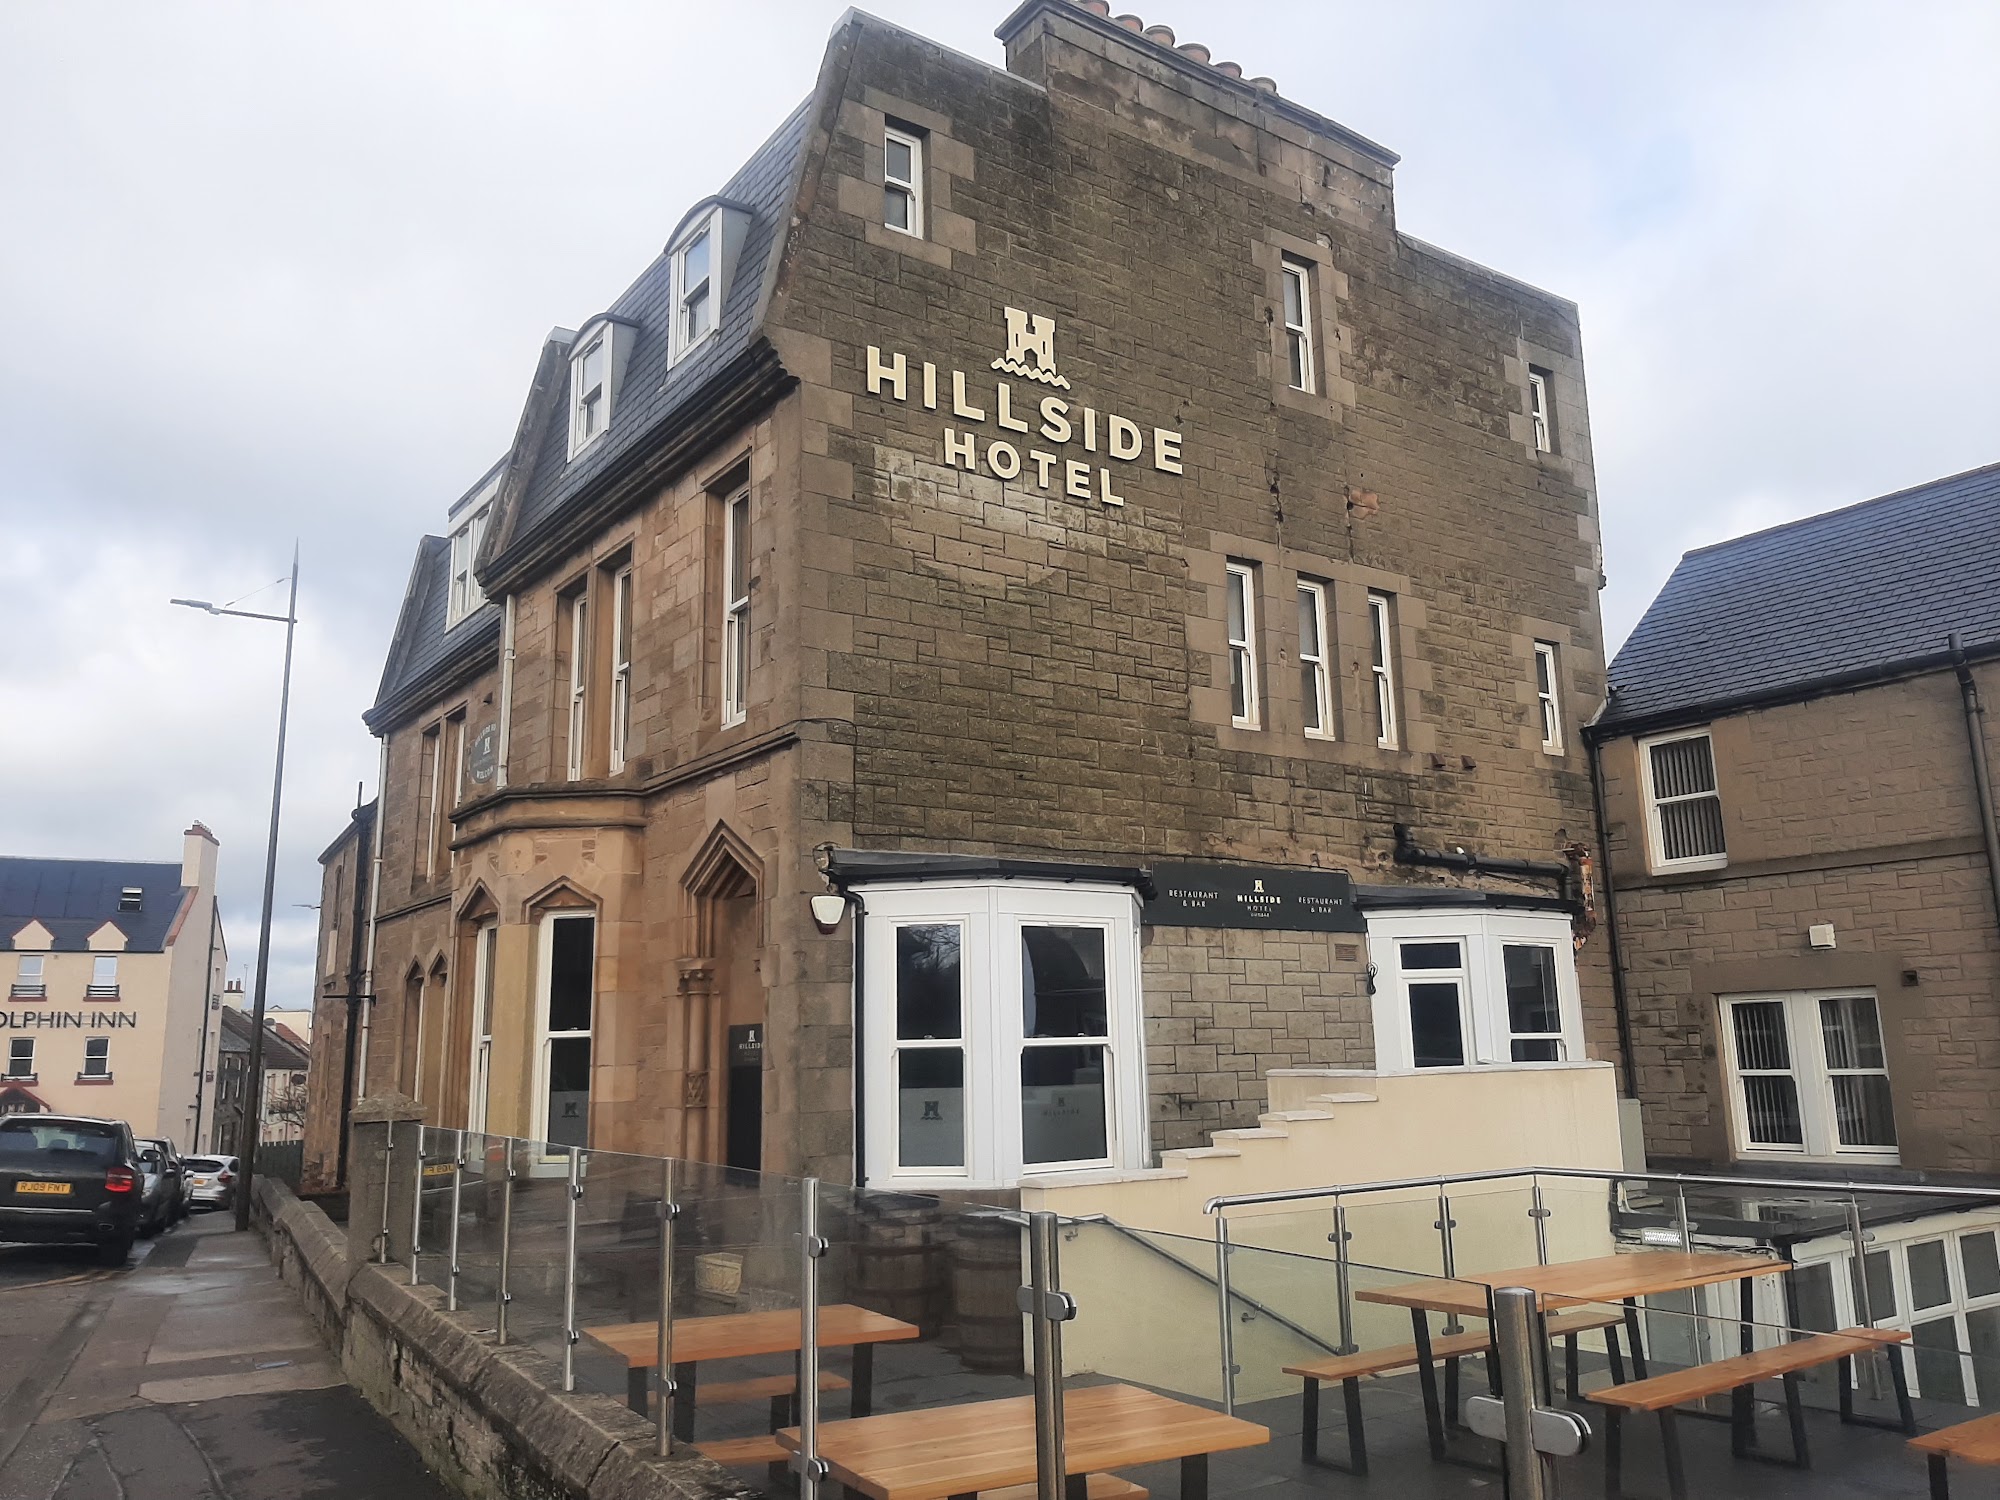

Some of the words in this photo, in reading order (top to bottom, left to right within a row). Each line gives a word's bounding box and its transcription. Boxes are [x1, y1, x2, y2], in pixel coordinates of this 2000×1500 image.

[866, 345, 1183, 475] HILLSIDE
[943, 428, 1125, 506] HOTEL
[1168, 889, 1219, 899] RESTAURANT
[1237, 894, 1281, 904] HILLSIDE
[1298, 896, 1343, 905] RESTAURANT
[91, 1011, 137, 1028] INN
[20, 1183, 45, 1191] RJ09
[47, 1184, 67, 1192] FNT
